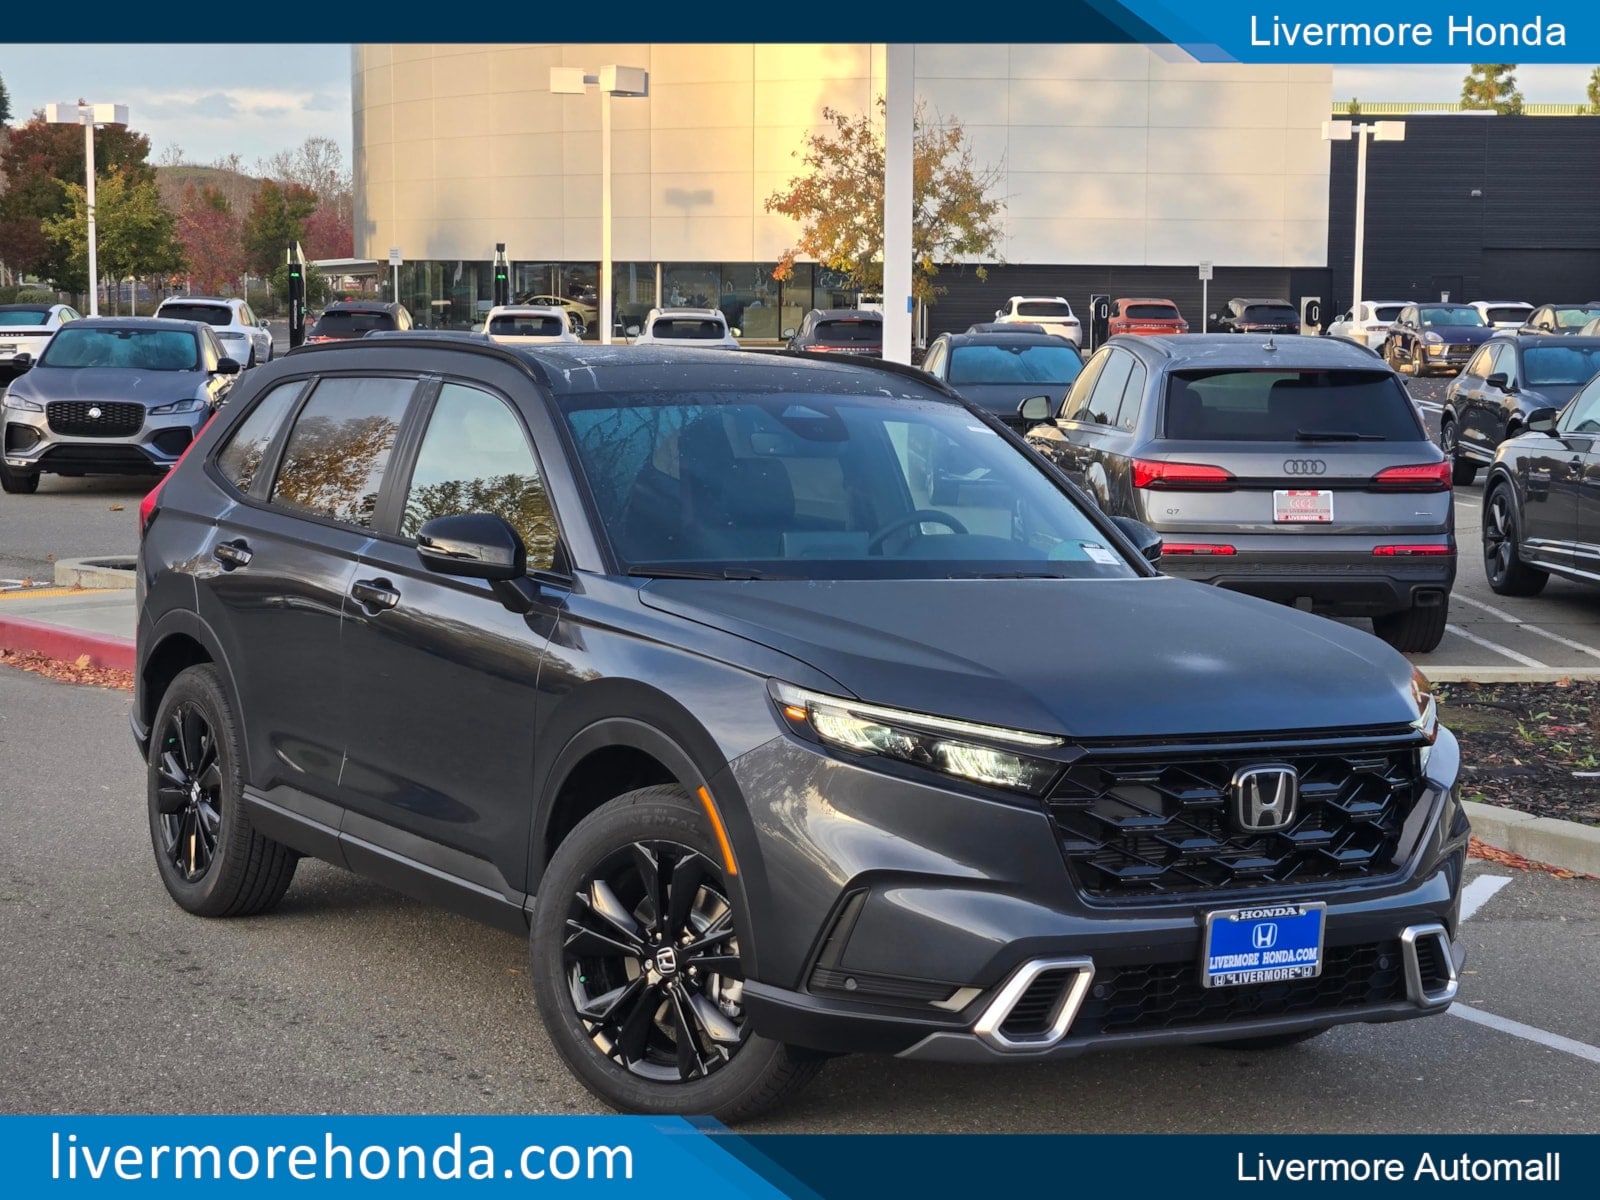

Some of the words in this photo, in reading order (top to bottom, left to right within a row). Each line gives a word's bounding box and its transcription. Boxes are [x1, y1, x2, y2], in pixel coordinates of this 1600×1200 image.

[1239, 906, 1298, 920] HONDA
[1208, 952, 1260, 970] LIVERMORE
[1262, 947, 1318, 965] HONDA.COM
[1232, 967, 1296, 985] LIVERMORE
